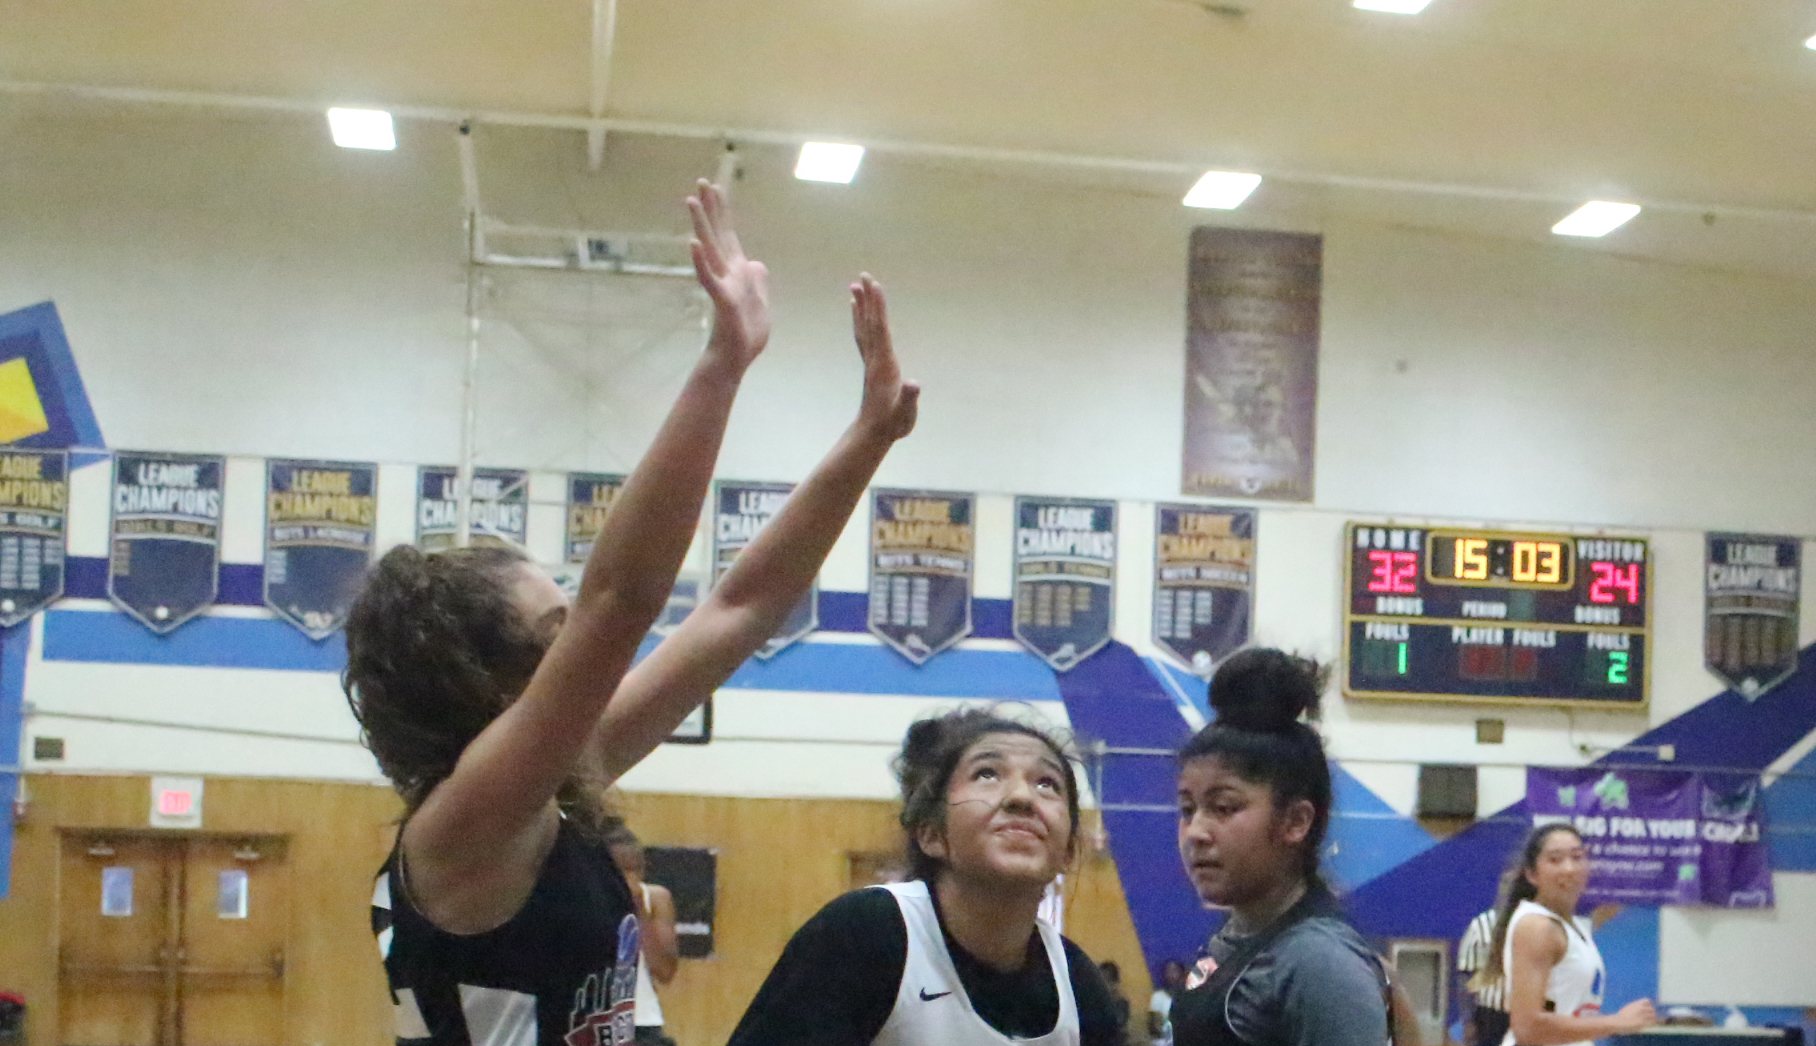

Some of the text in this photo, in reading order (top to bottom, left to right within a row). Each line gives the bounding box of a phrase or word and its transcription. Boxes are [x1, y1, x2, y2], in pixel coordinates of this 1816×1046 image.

[139, 462, 200, 487] LEAGUE
[291, 469, 351, 495] LEAGUE
[115, 481, 220, 518] CHAMPIONS
[1037, 506, 1096, 531] LEAGUE
[1017, 527, 1114, 559] CHAMPIONS
[1577, 540, 1645, 562] VISITOR
[1368, 551, 1418, 593] 32
[1590, 562, 1639, 604] 24
[1376, 596, 1424, 615] BONUS
[1461, 600, 1507, 619] PERIOD
[1574, 603, 1620, 624] BONUS
[1365, 622, 1410, 640] FOULS
[1452, 626, 1556, 648] PLAYER FOULS
[1587, 632, 1630, 650] FOULS
[1398, 643, 1408, 674] 1
[1608, 651, 1628, 683] 2
[1609, 816, 1647, 838] FOR
[1647, 819, 1697, 839] YOUR
